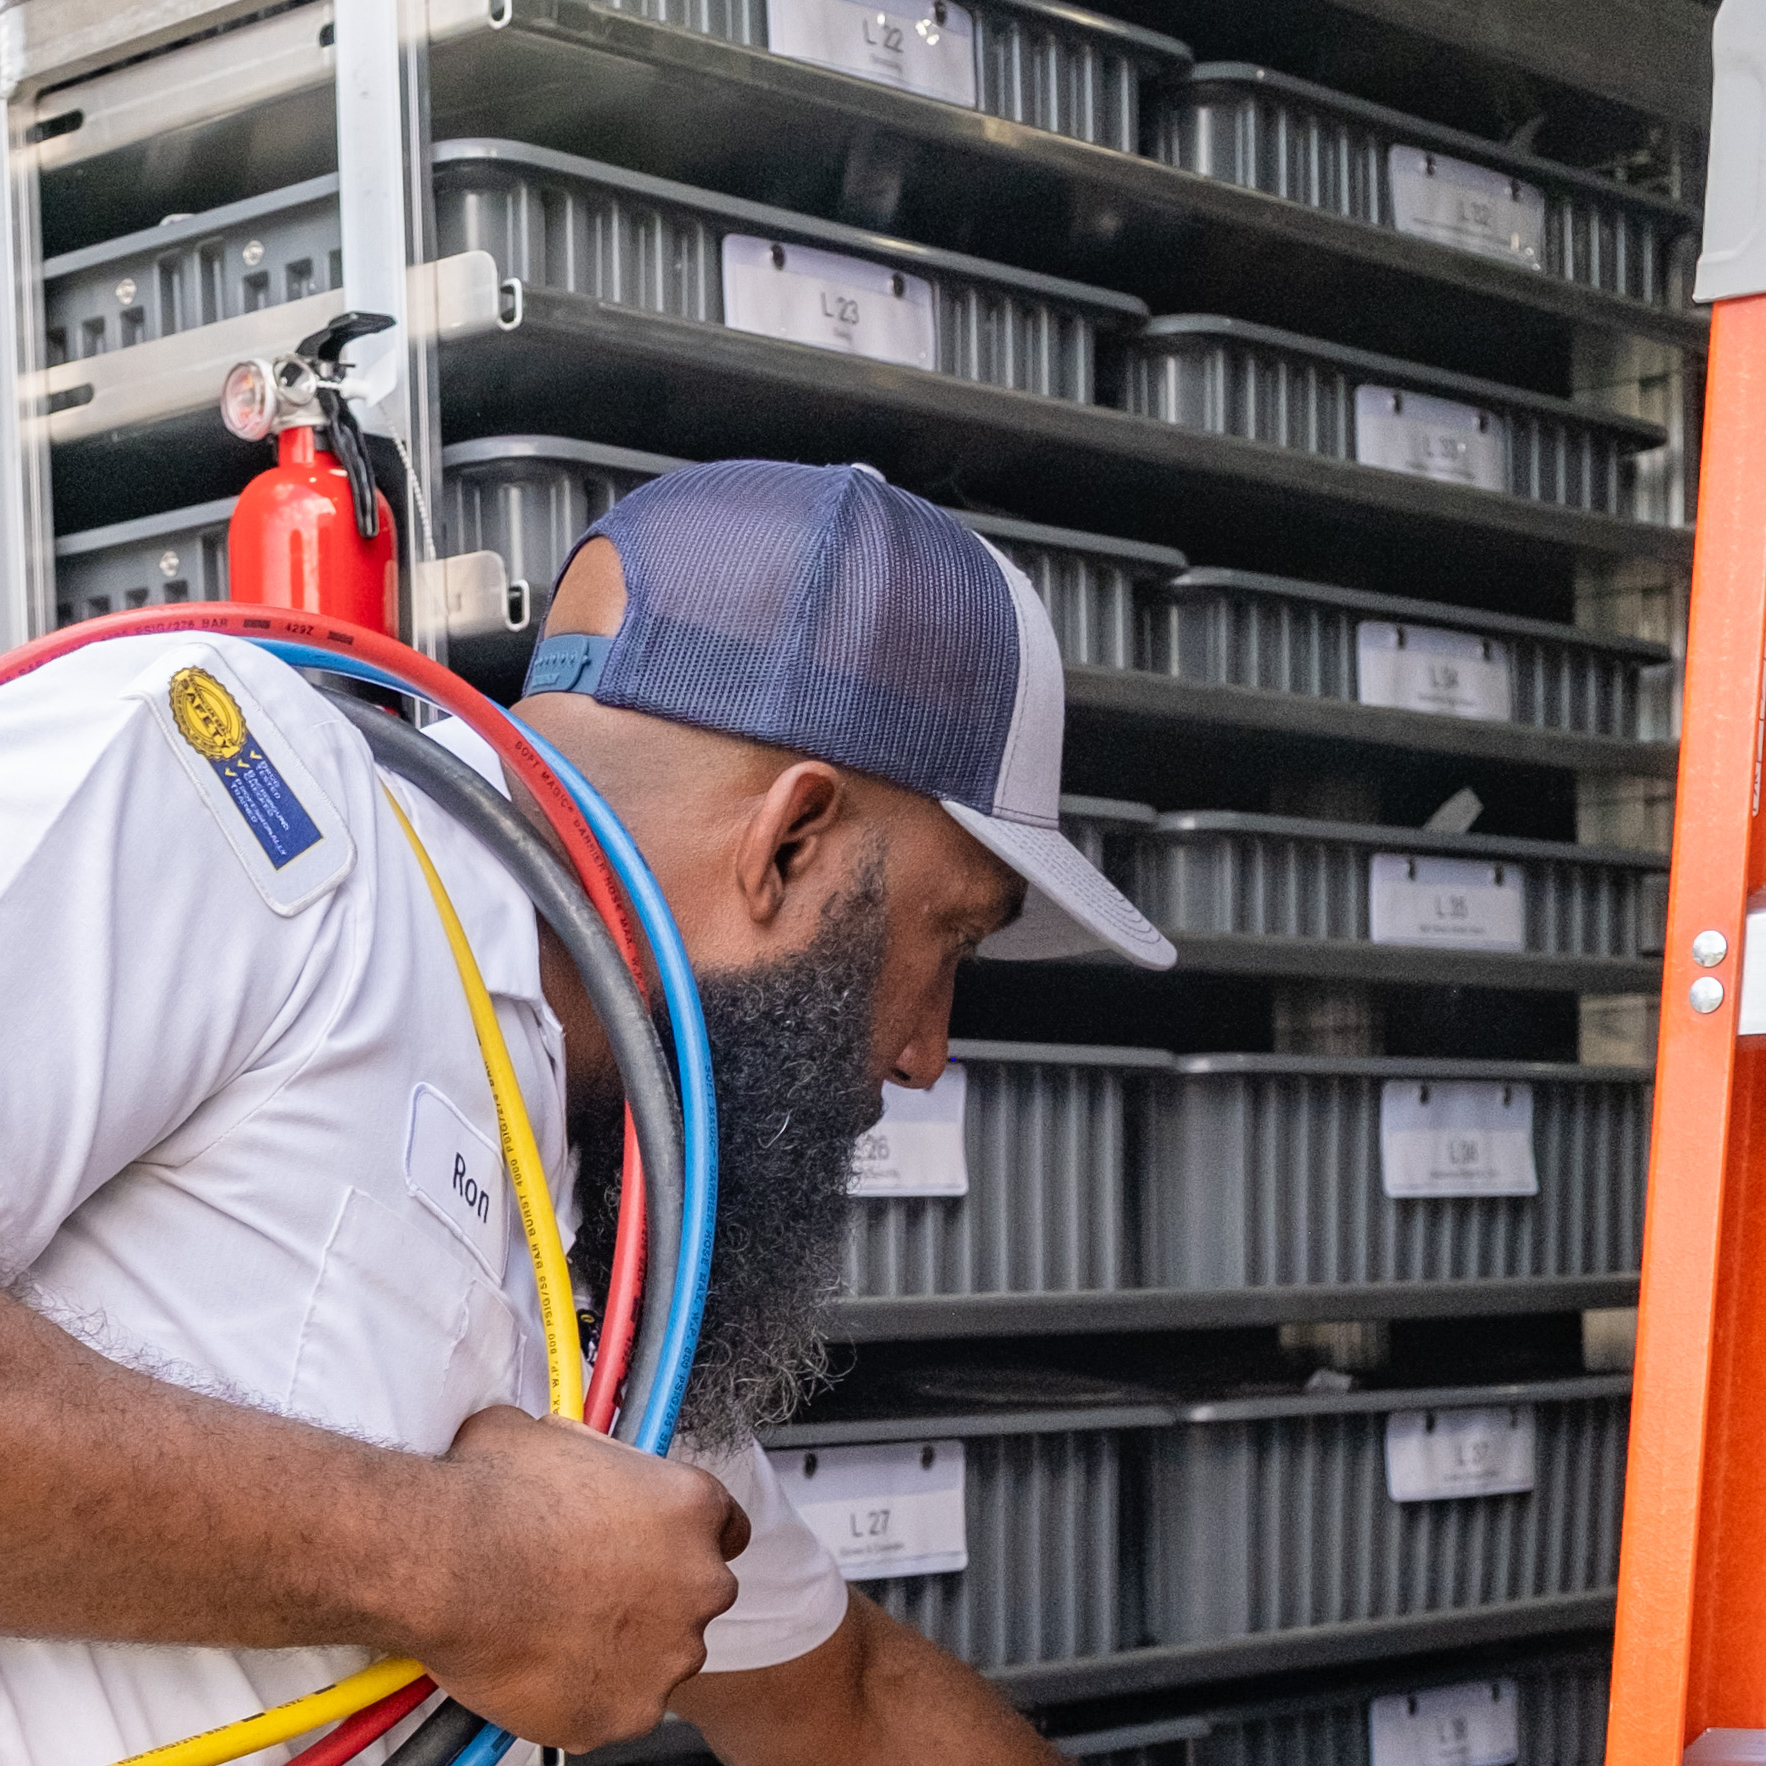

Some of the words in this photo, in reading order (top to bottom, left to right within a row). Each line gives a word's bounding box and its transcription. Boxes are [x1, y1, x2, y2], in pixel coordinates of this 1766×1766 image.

[177, 677, 230, 753] SAFETY
[453, 1152, 490, 1223] Ron
[530, 1242, 543, 1268] BAR
[868, 1509, 890, 1536] 27
